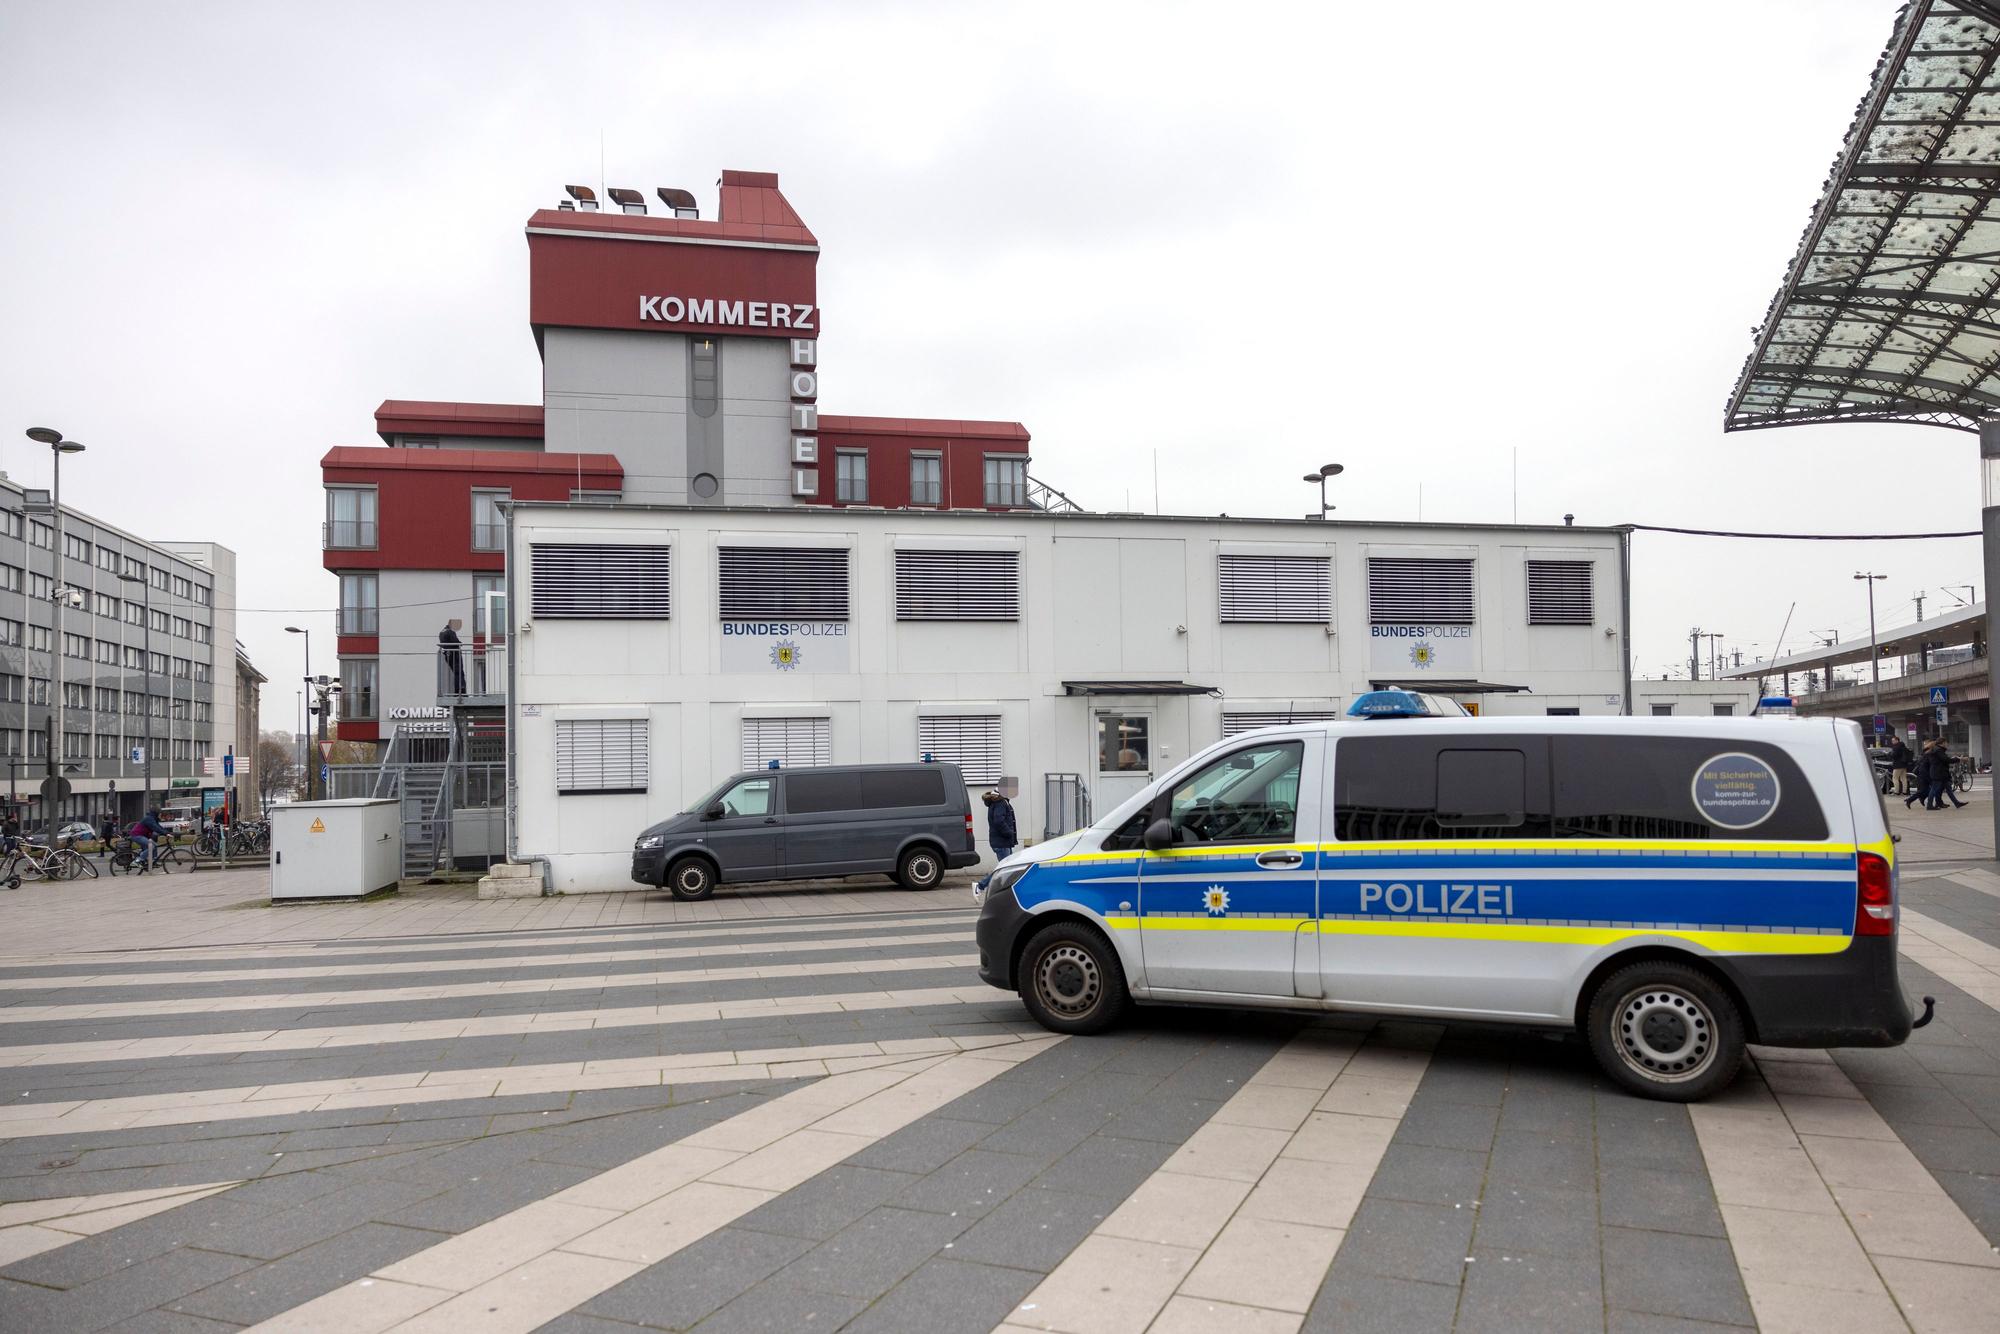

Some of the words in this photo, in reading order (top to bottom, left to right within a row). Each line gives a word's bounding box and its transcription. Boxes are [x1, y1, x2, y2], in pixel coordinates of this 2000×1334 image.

[640, 295, 814, 329] KOMMERZ
[793, 339, 816, 495] HOTEL
[723, 623, 847, 636] BUNDESPOLIZEI
[1371, 626, 1471, 638] BUNDESPOLIZEI
[389, 707, 450, 718] KOMMER
[403, 722, 450, 732] HOTEL
[1703, 771, 1718, 780] Mit
[1719, 771, 1768, 780] Sicherheit
[1715, 781, 1757, 790] vielfältig.
[1703, 799, 1771, 807] bundespolizei.de
[1360, 883, 1513, 916] POLIZEI
